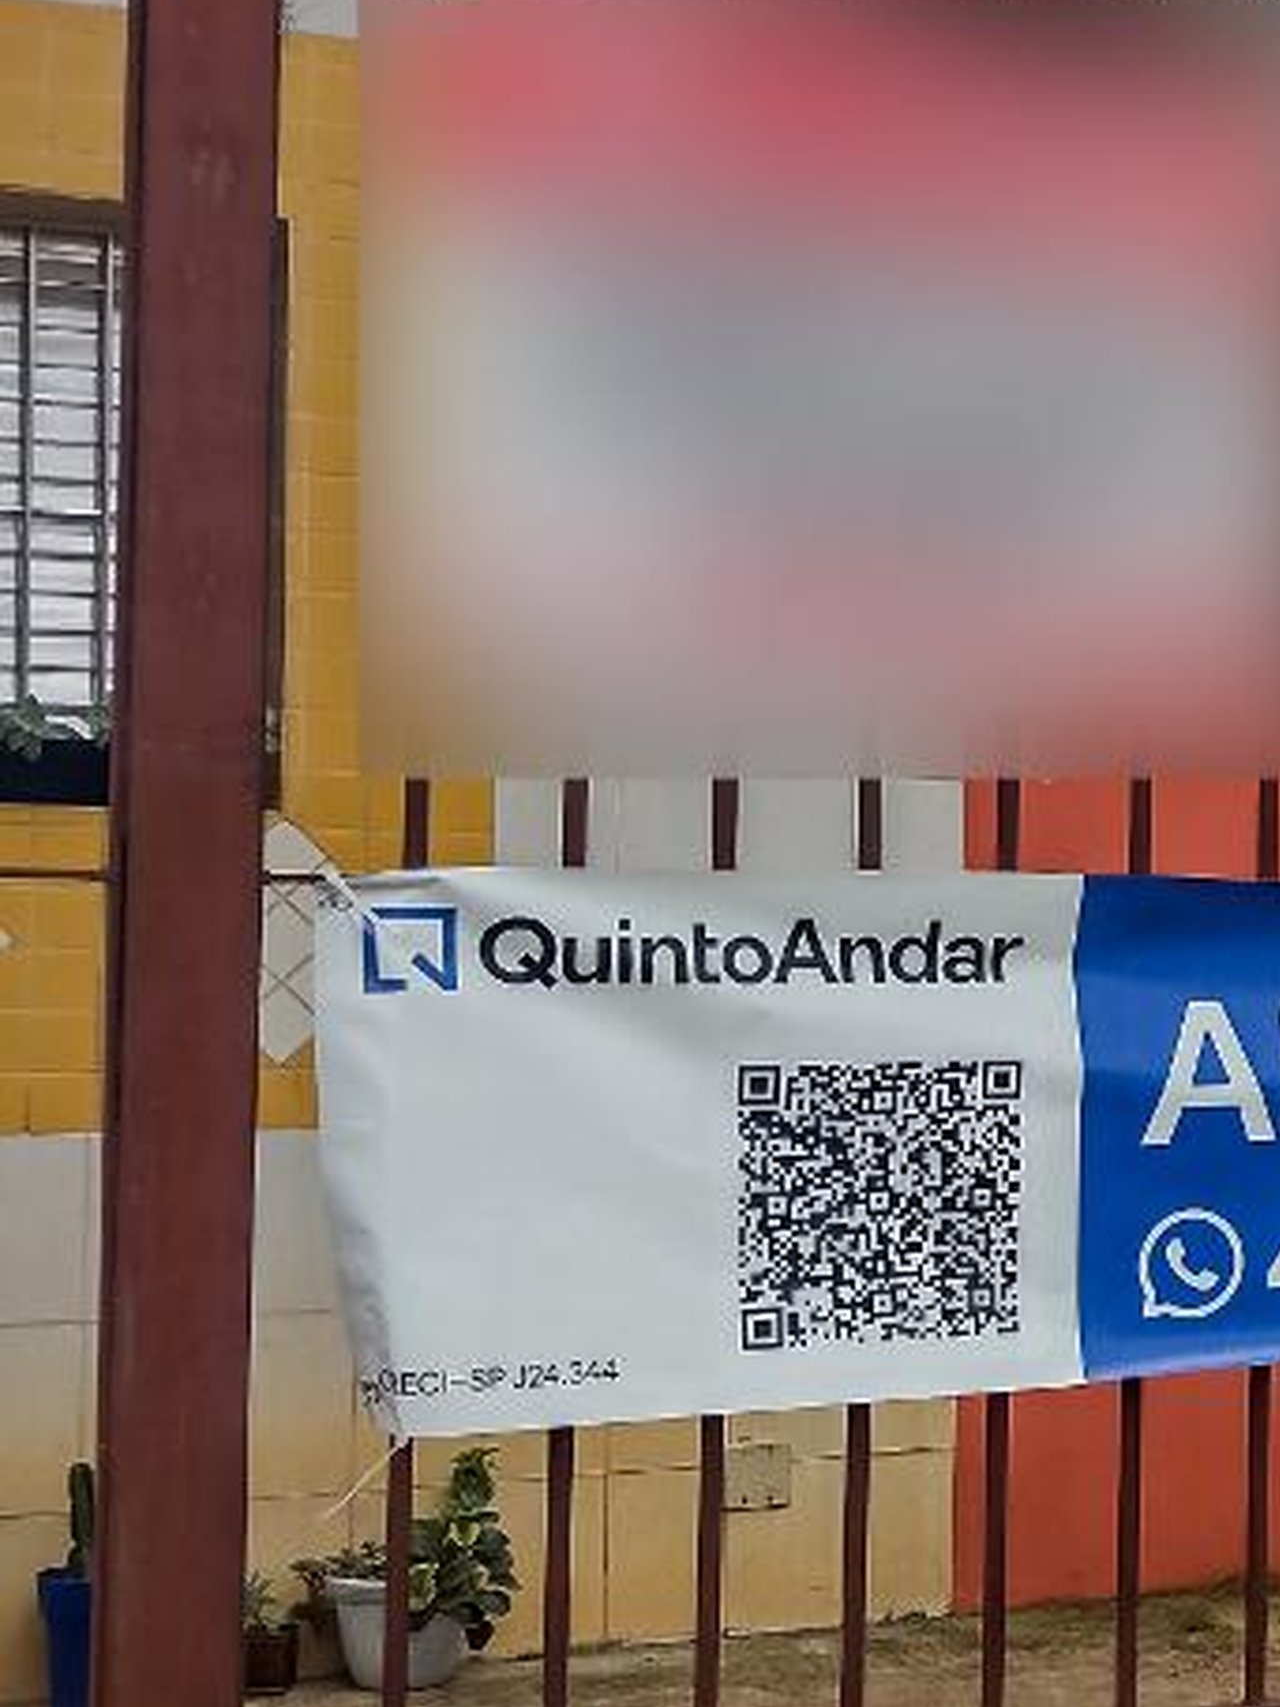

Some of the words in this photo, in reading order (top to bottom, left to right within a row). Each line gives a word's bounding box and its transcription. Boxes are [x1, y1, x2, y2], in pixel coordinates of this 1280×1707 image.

[478, 915, 1024, 990] QuintoAndar
[361, 1364, 507, 1404] RECI-SP
[512, 1357, 621, 1391] J24.344
